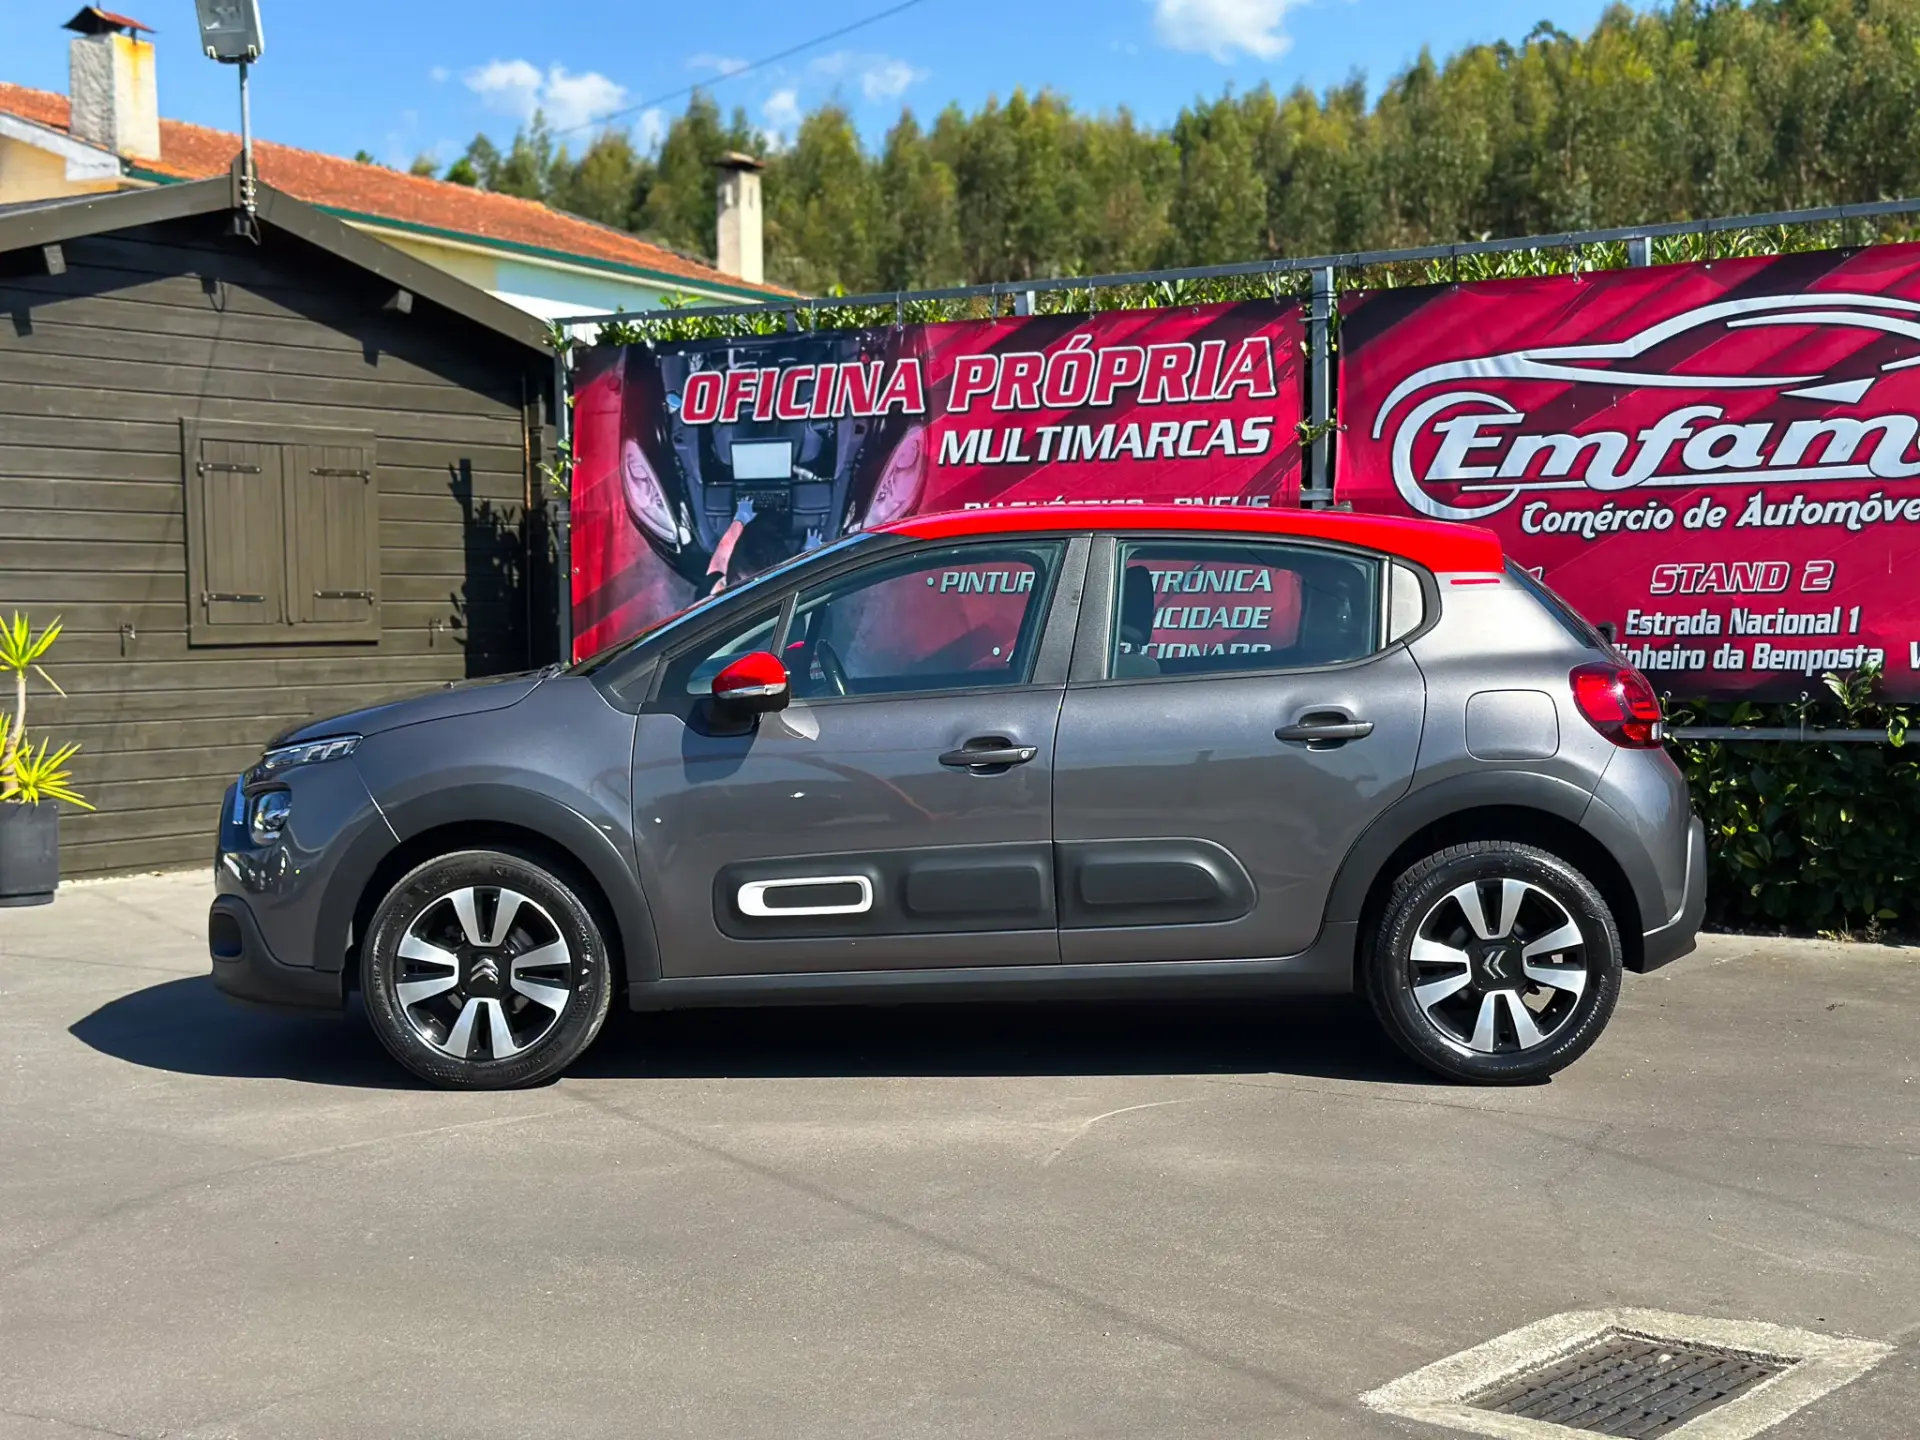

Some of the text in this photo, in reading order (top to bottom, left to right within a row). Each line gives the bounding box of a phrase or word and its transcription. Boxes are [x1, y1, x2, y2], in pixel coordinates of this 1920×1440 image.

[680, 334, 1277, 425] OFICINA PRÓPRIA
[938, 416, 1274, 465] MULTIMARCAS
[1423, 404, 1920, 491] Emfam
[1521, 501, 1674, 538] Comércio
[1684, 498, 1726, 529] de
[1650, 560, 1835, 595] STAND 2
[1625, 605, 1860, 635] Estrada Nacional 1
[1612, 643, 1705, 670] inheiro
[1713, 643, 1744, 669] da
